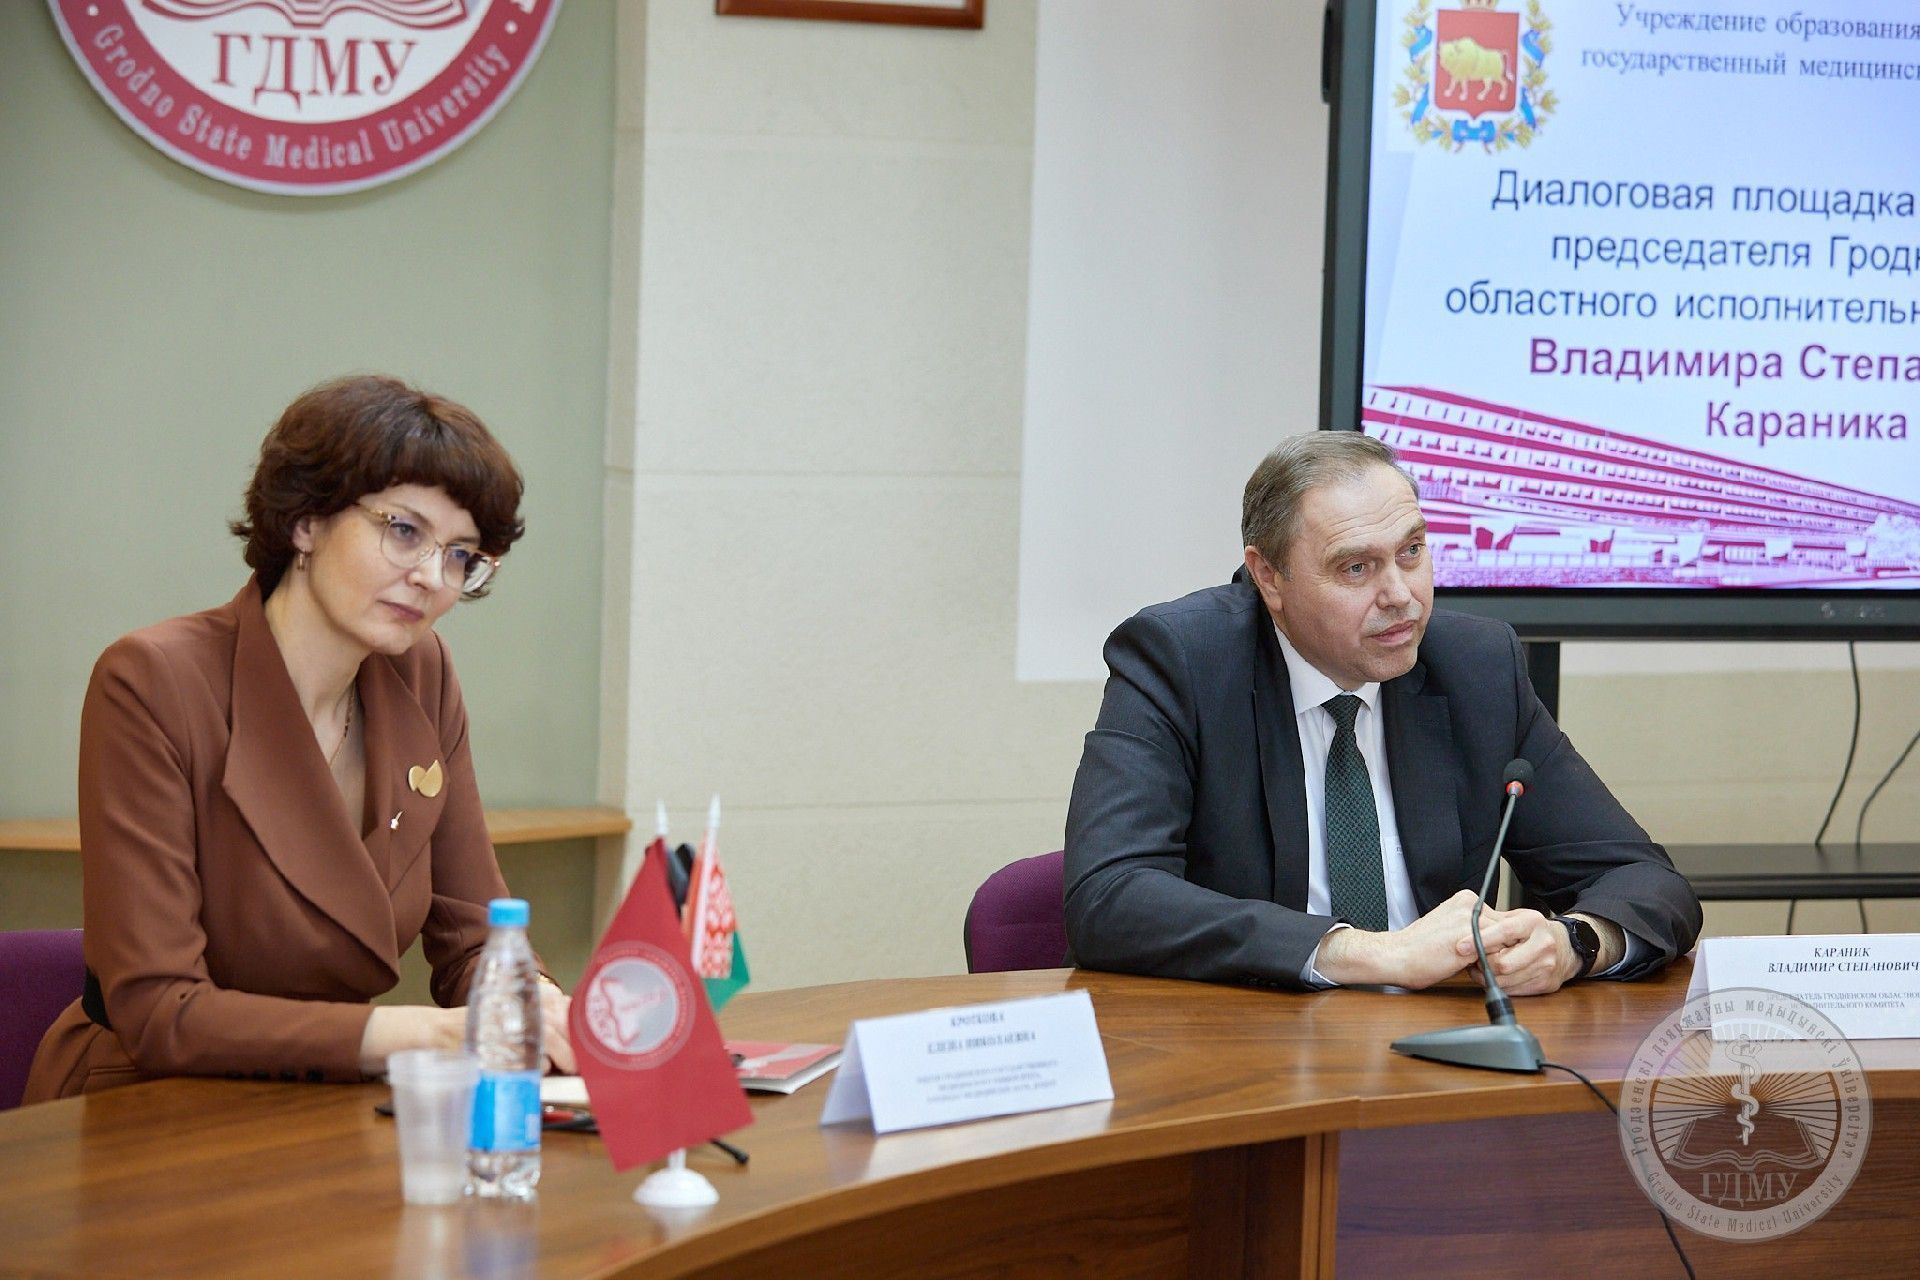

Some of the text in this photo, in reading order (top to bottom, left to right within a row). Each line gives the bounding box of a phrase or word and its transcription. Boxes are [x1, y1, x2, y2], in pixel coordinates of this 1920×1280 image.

[1616, 3, 1920, 42] Учреждение образования
[212, 32, 417, 111] ГДМУ
[1581, 49, 1920, 81] государственный медицинс
[93, 24, 512, 169] Grodno State Medical University
[1491, 169, 1914, 221] Диалоговая площадка
[1552, 234, 1810, 271] председателя
[1446, 280, 1657, 320] областного
[1529, 338, 1920, 387] Владимира Степа
[1706, 401, 1908, 446] Караника
[1768, 963, 1835, 973] ВЛАДИМИР
[1814, 947, 1871, 958] КАРАНИК
